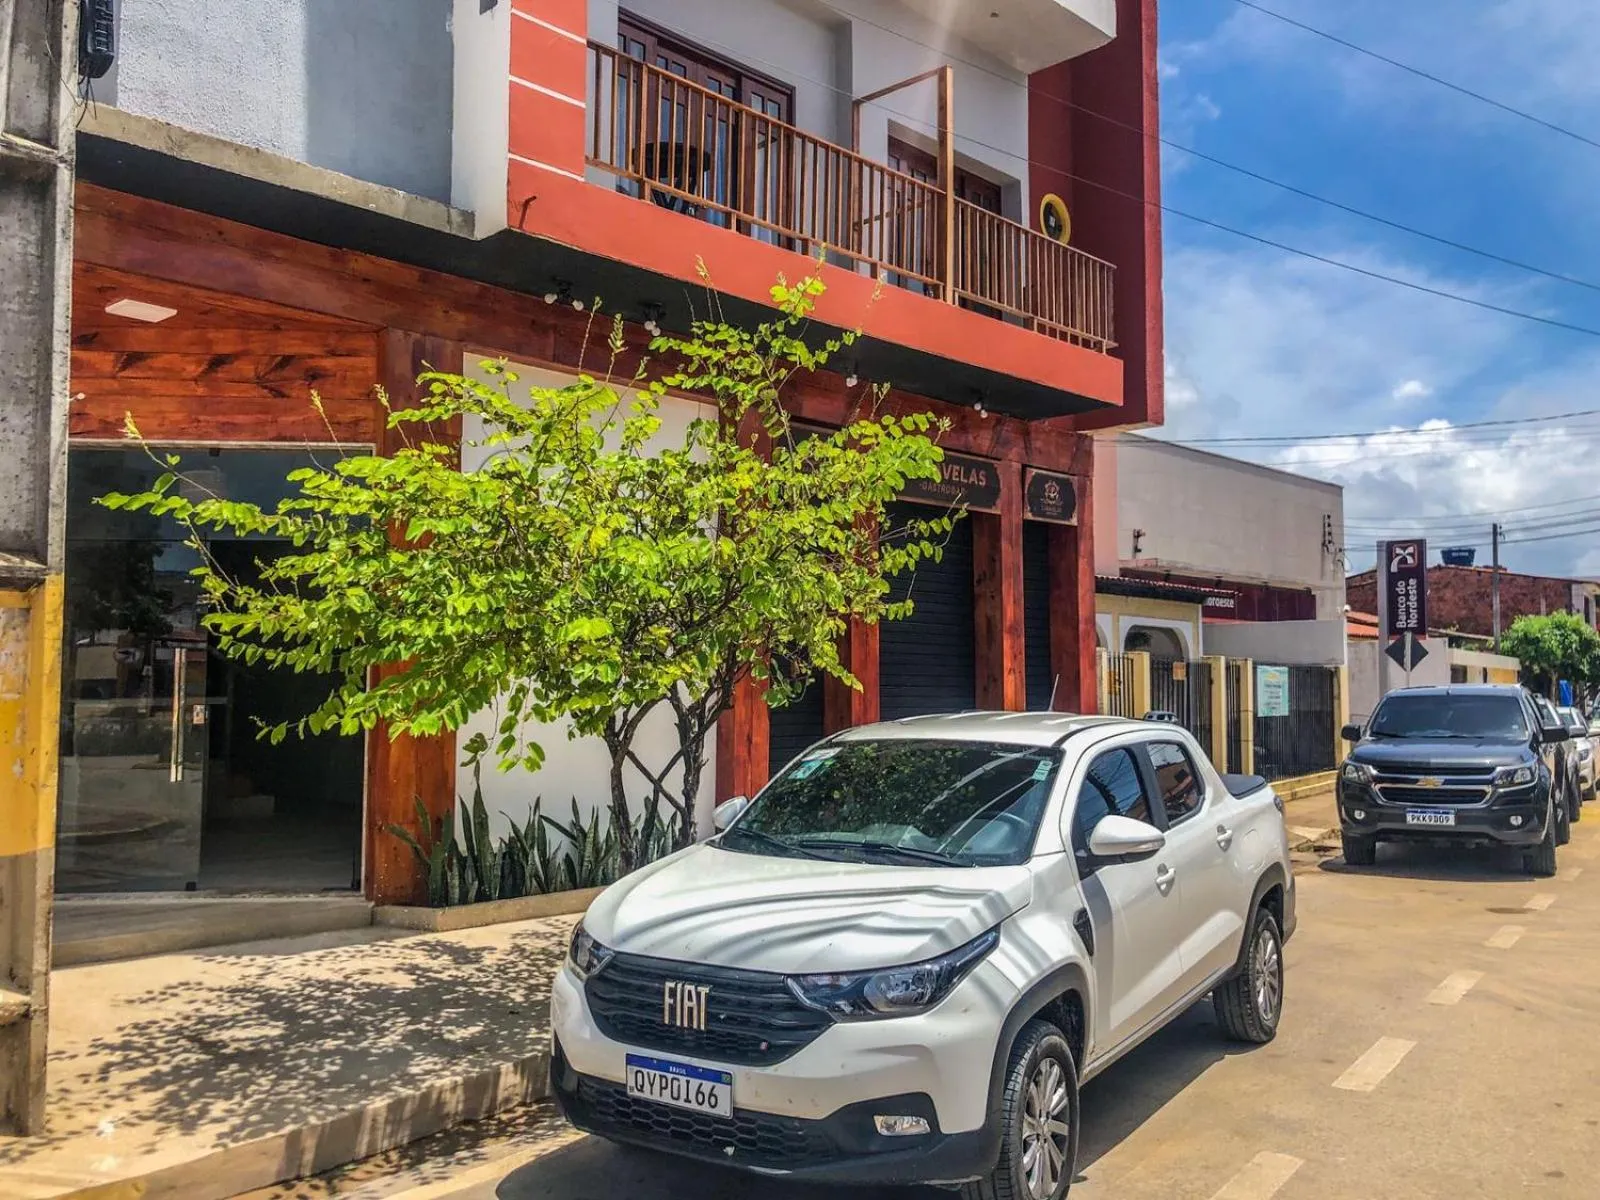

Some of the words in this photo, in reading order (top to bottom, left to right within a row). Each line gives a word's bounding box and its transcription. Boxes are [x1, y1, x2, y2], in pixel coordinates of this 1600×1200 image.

[1395, 580, 1406, 595] do
[1407, 578, 1418, 628] Nordeste
[1395, 595, 1407, 628] Banco
[663, 980, 710, 1031] FIAT
